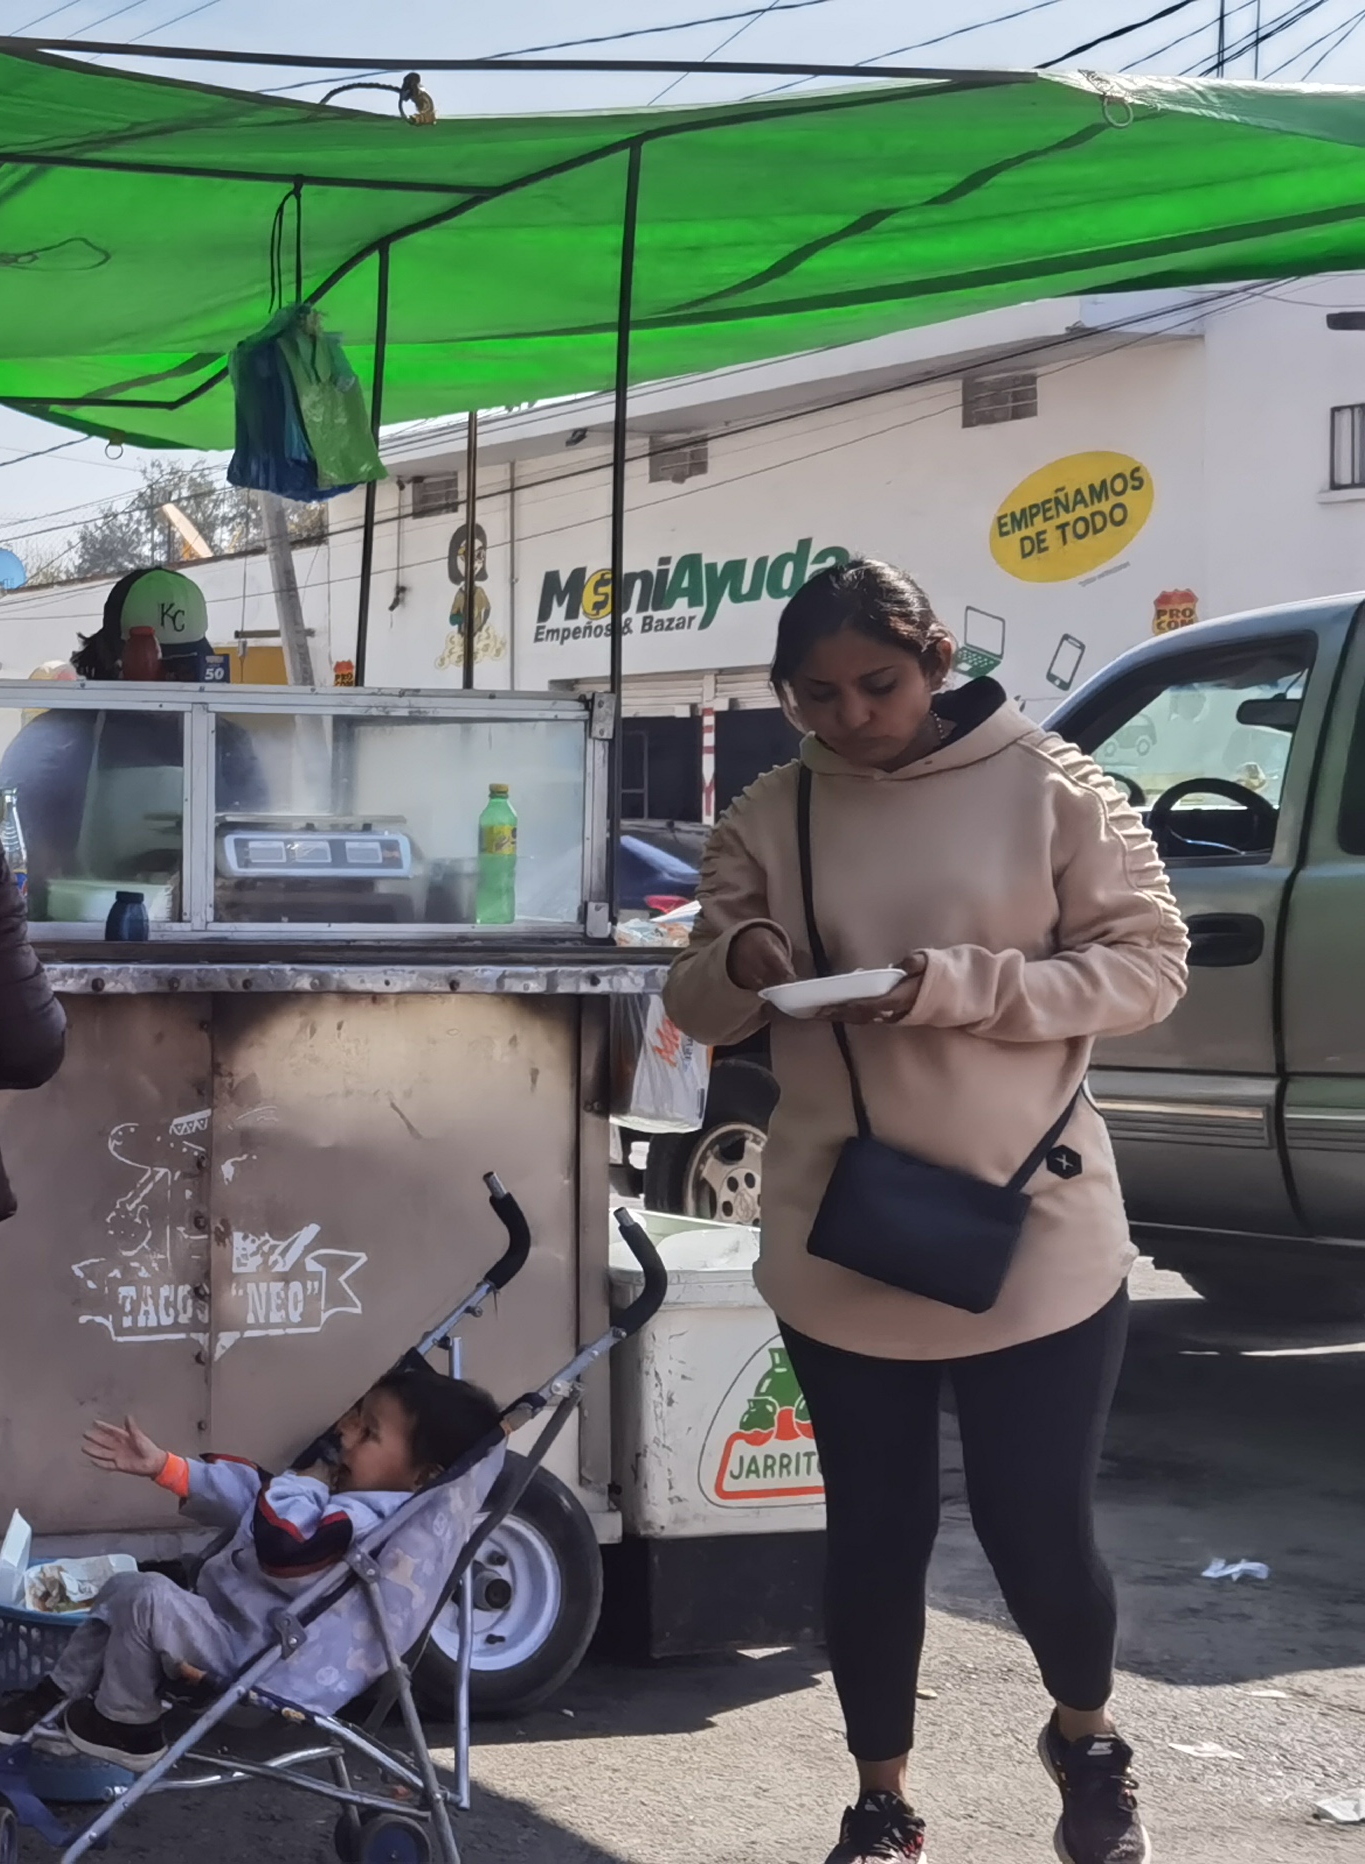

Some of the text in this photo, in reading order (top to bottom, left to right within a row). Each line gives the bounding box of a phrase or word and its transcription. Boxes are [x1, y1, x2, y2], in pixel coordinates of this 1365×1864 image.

[996, 466, 1145, 538] EMPEÑAMOS
[1019, 502, 1129, 559] DE TODO
[160, 602, 186, 632] KC
[1156, 607, 1195, 620] PRO
[533, 614, 697, 646] Empeños & Bazar
[204, 667, 225, 680] 50
[118, 1283, 210, 1328] TACOS
